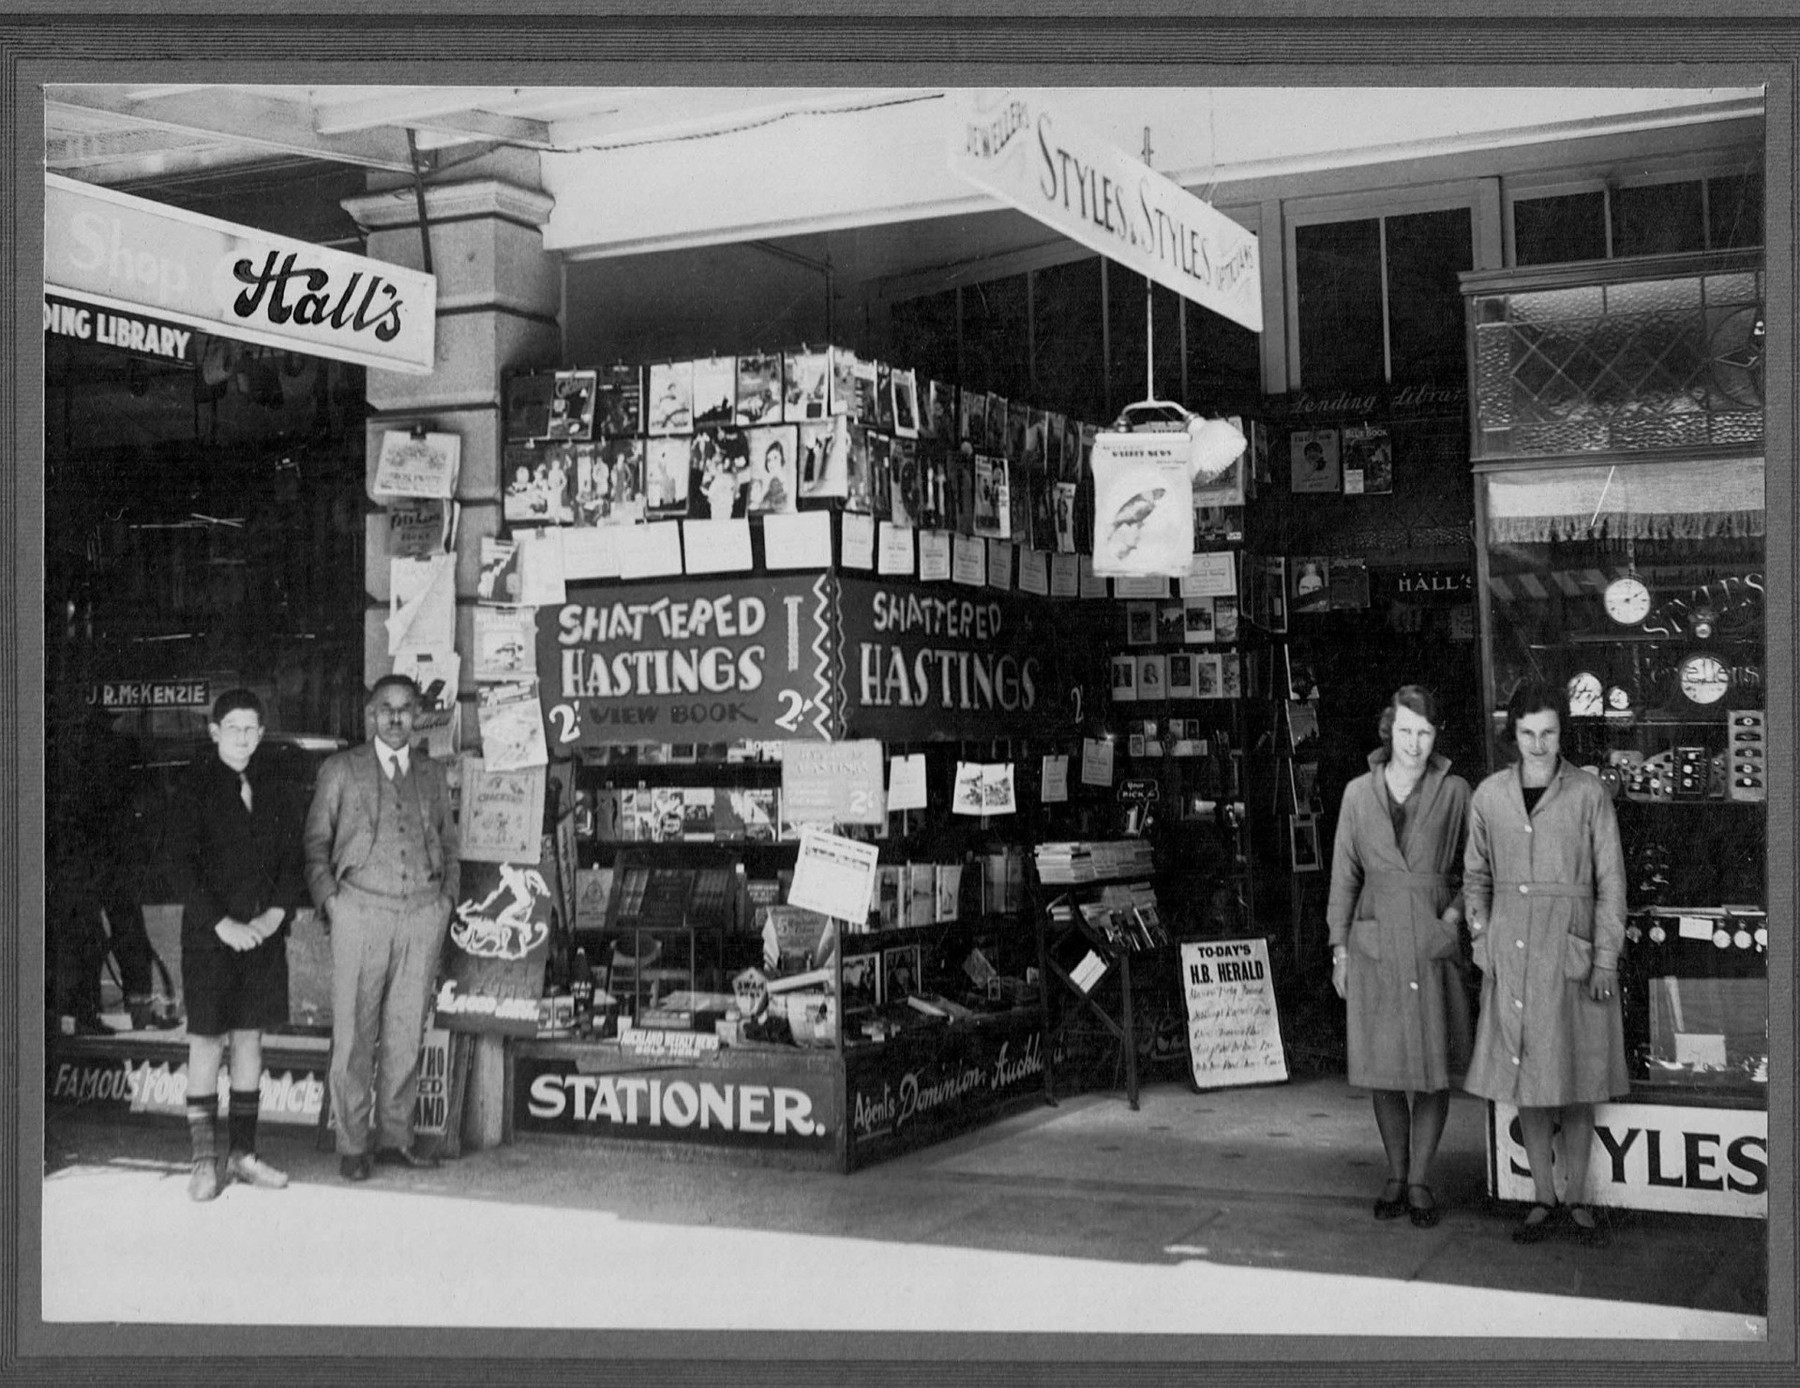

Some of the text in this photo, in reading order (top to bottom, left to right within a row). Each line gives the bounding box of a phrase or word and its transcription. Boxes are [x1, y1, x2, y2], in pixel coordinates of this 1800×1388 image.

[1037, 110, 1127, 241] STYLES
[1138, 176, 1212, 286] STYLES
[233, 250, 403, 342] Hall's
[96, 312, 192, 360] LIBRARY
[1366, 427, 1388, 438] BOOK
[558, 594, 766, 645] SHATTERED
[872, 590, 1002, 640] SHATTERED
[561, 645, 766, 698] HASTINGS
[860, 642, 1040, 712] HASTINGS
[590, 702, 758, 725] VIEW BOOK
[1190, 960, 1264, 985] H.B. HERALD
[1198, 944, 1252, 958] TO-DAY'S
[695, 1034, 720, 1050] NEWS
